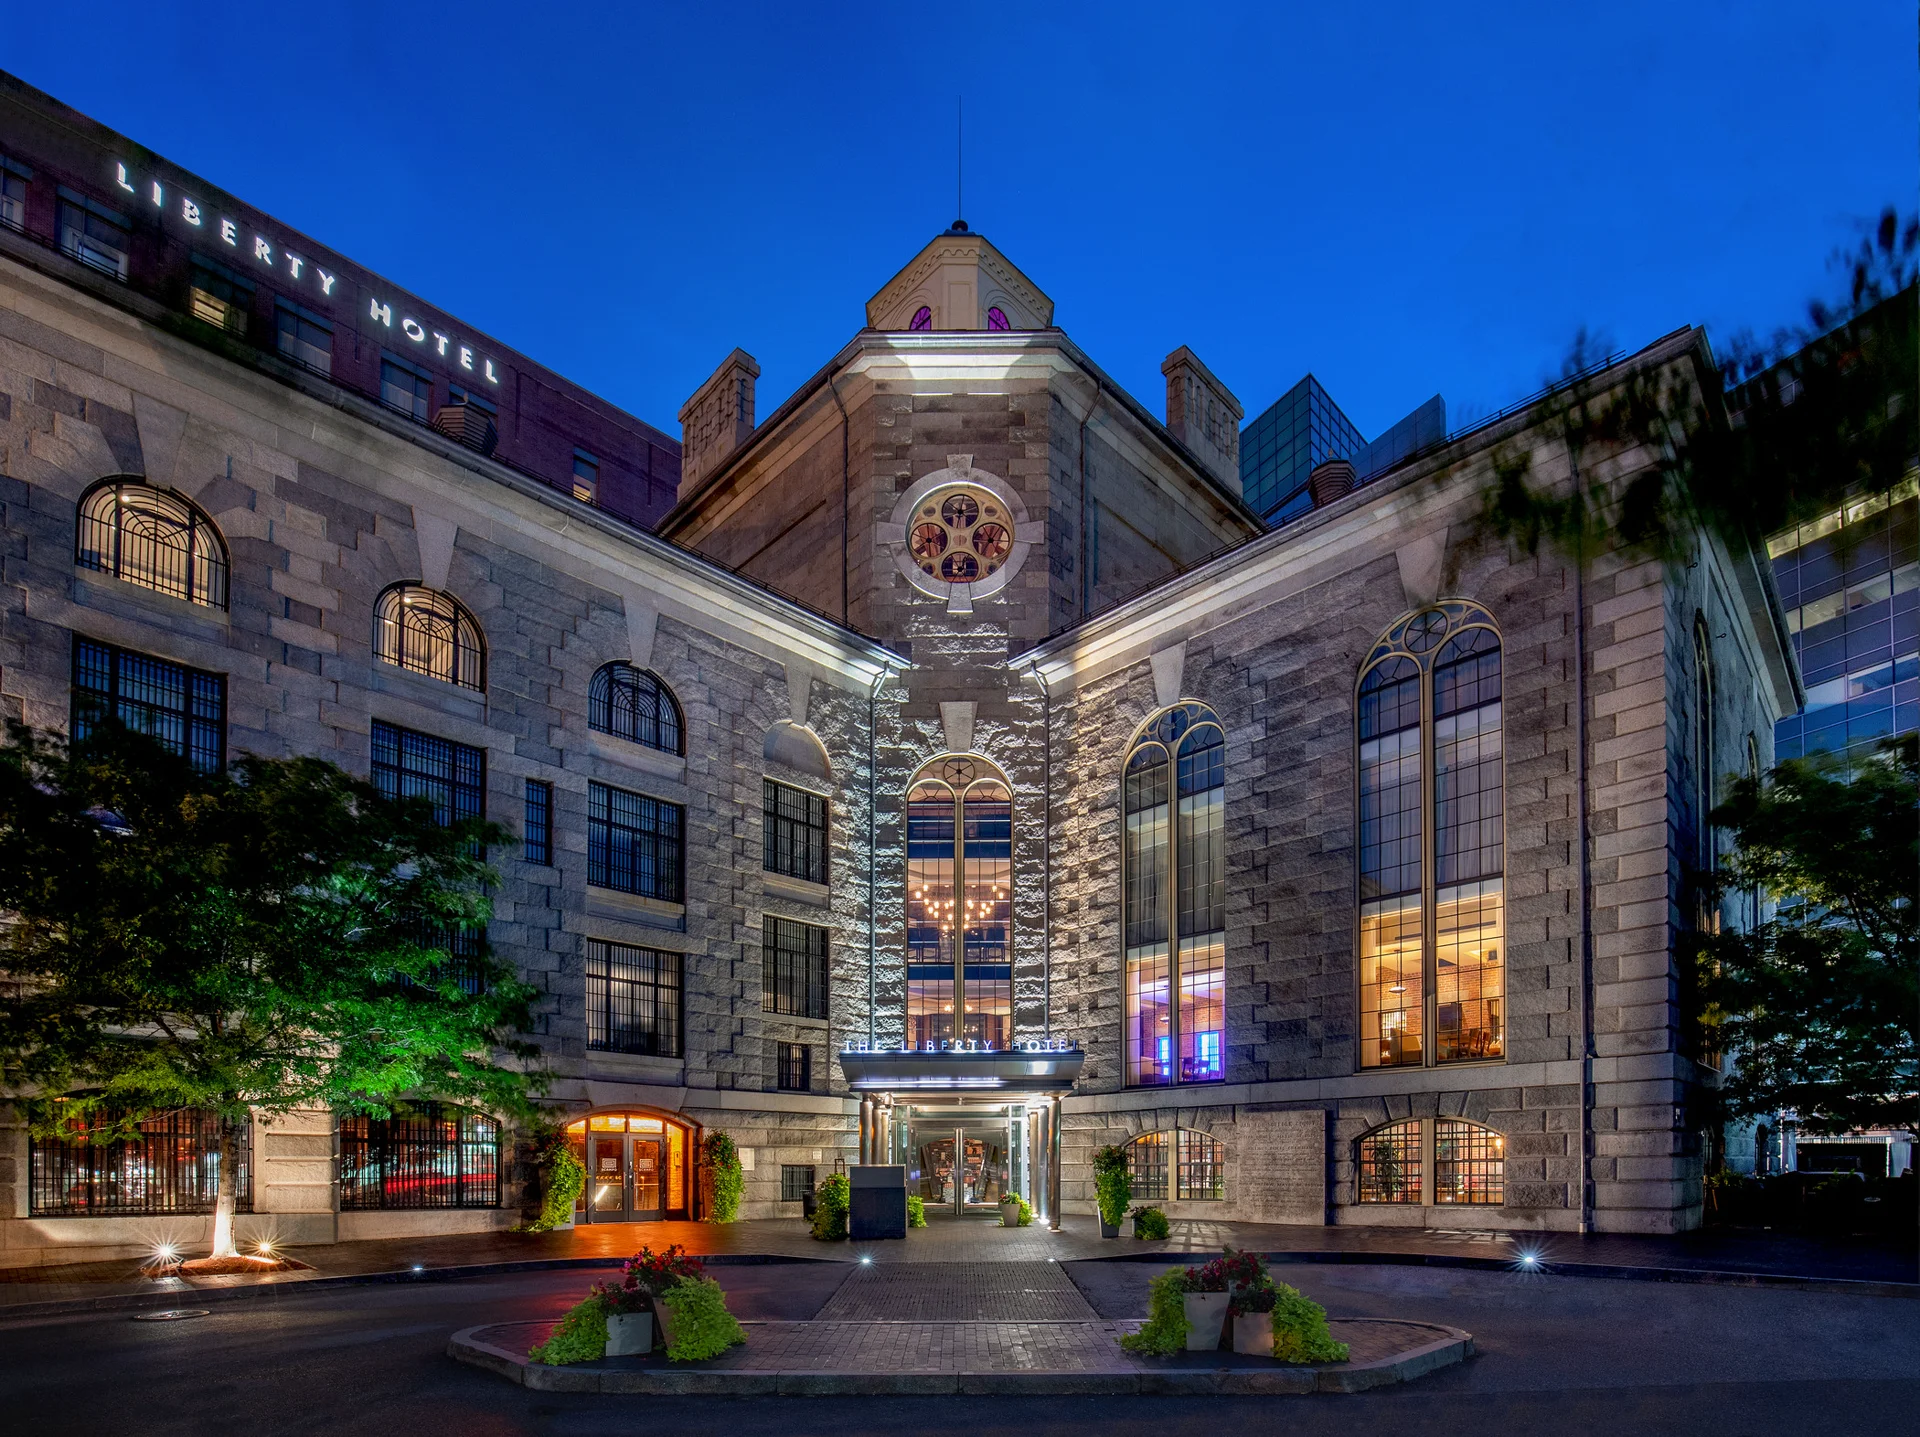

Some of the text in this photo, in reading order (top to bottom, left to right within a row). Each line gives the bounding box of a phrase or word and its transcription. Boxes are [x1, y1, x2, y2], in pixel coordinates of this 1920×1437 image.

[116, 162, 499, 385] LIBERTY HOTEL
[844, 1039, 883, 1051] THE
[901, 1039, 992, 1051] LIBERTY
